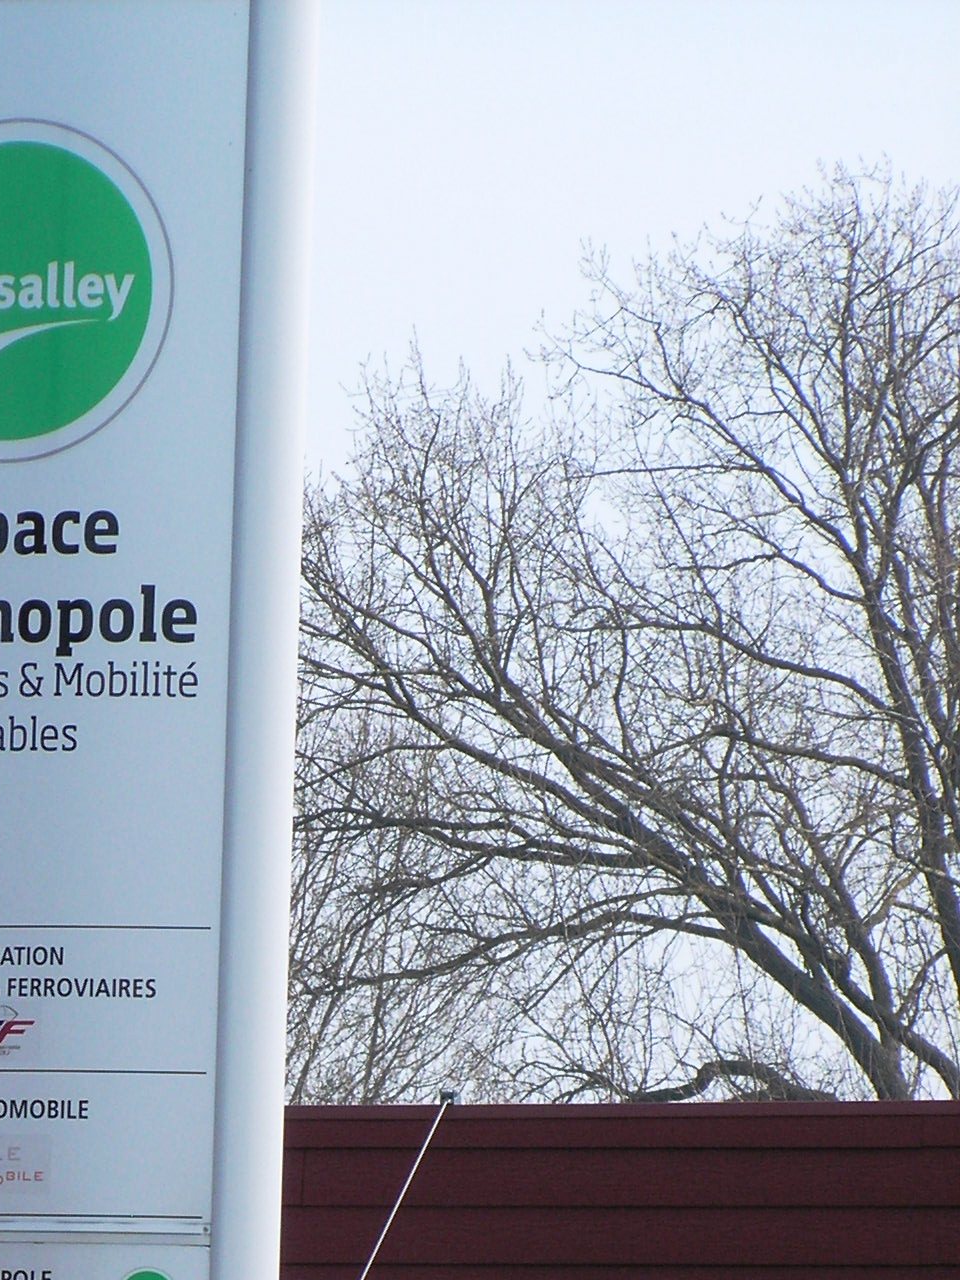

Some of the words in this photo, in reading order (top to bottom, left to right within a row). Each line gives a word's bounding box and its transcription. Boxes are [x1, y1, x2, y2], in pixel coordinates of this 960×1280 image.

[18, 662, 44, 698] &
[53, 661, 199, 698] Mobilité
[7, 978, 156, 998] FERROVIAIRES
